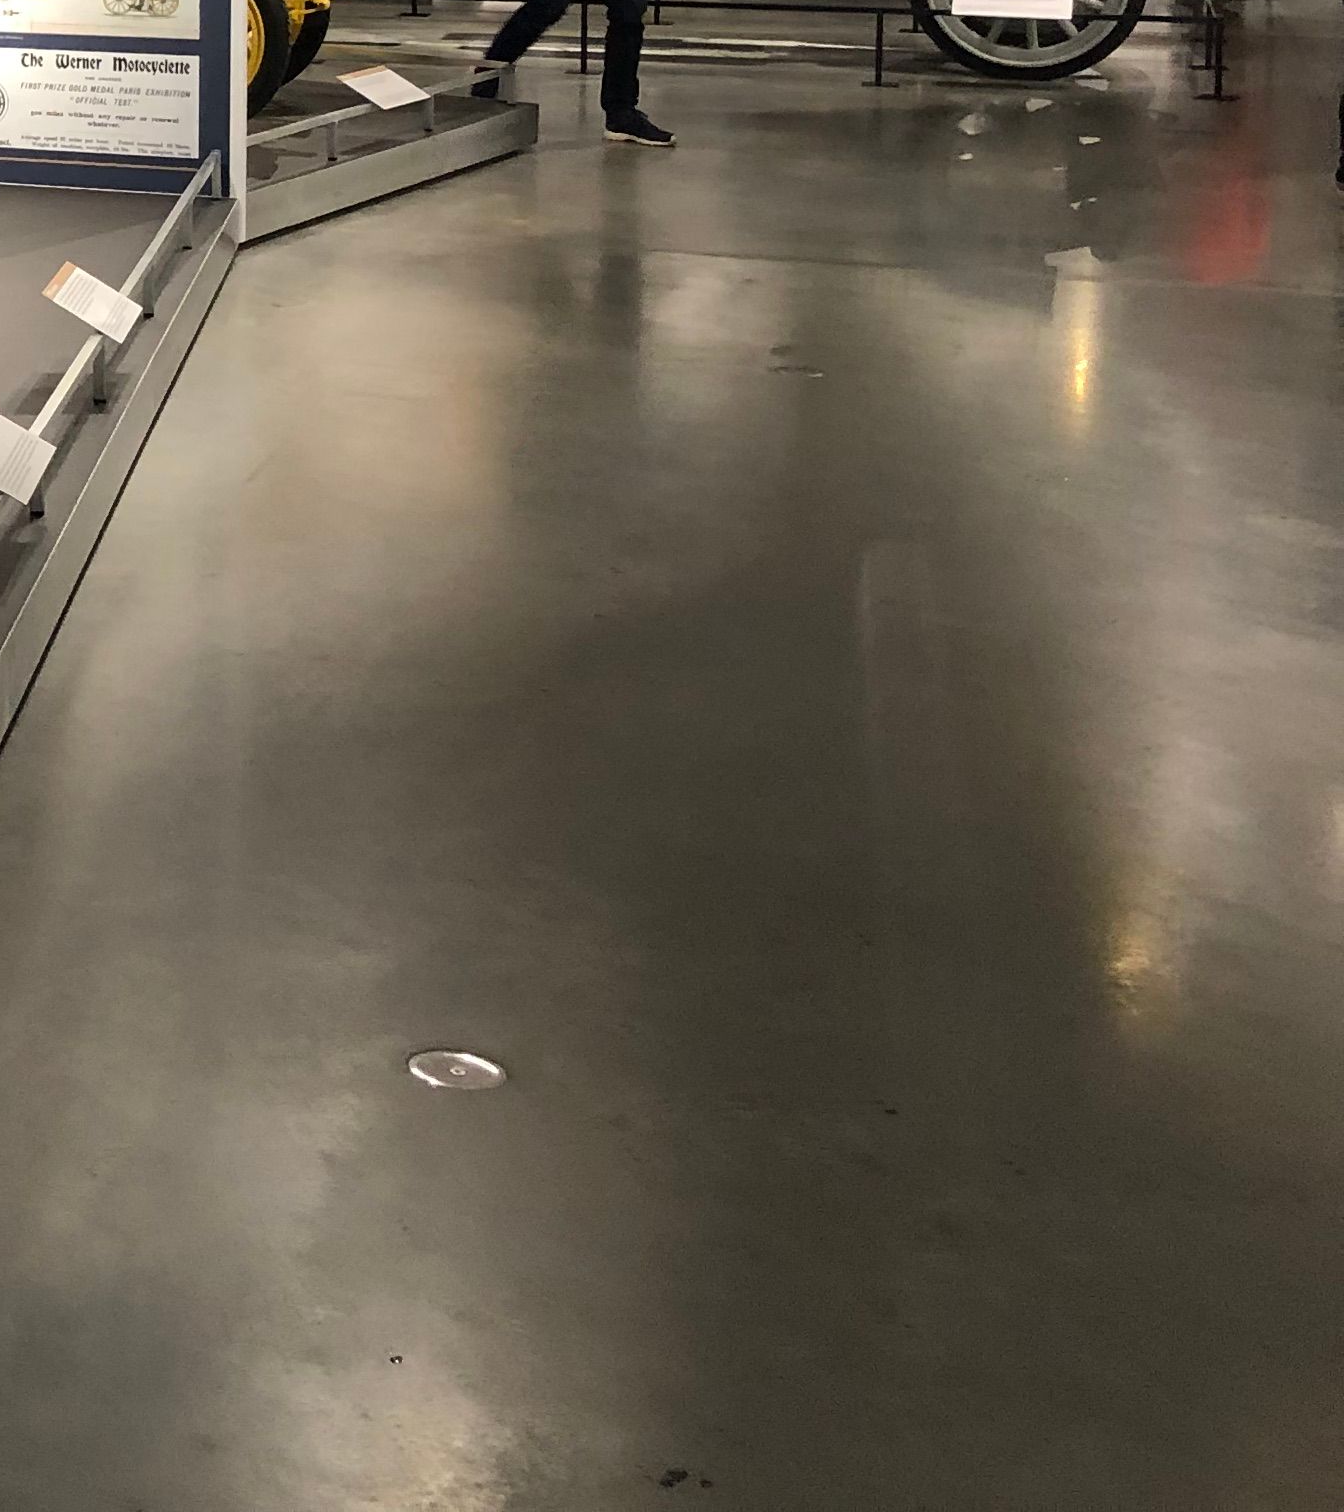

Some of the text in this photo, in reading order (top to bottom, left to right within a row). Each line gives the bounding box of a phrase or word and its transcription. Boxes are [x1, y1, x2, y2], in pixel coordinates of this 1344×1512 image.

[21, 52, 191, 76] The Werner Motocyclette
[20, 82, 191, 98] FIRST PRIZE GOLD MEDAL PARIS EXHIBITION
